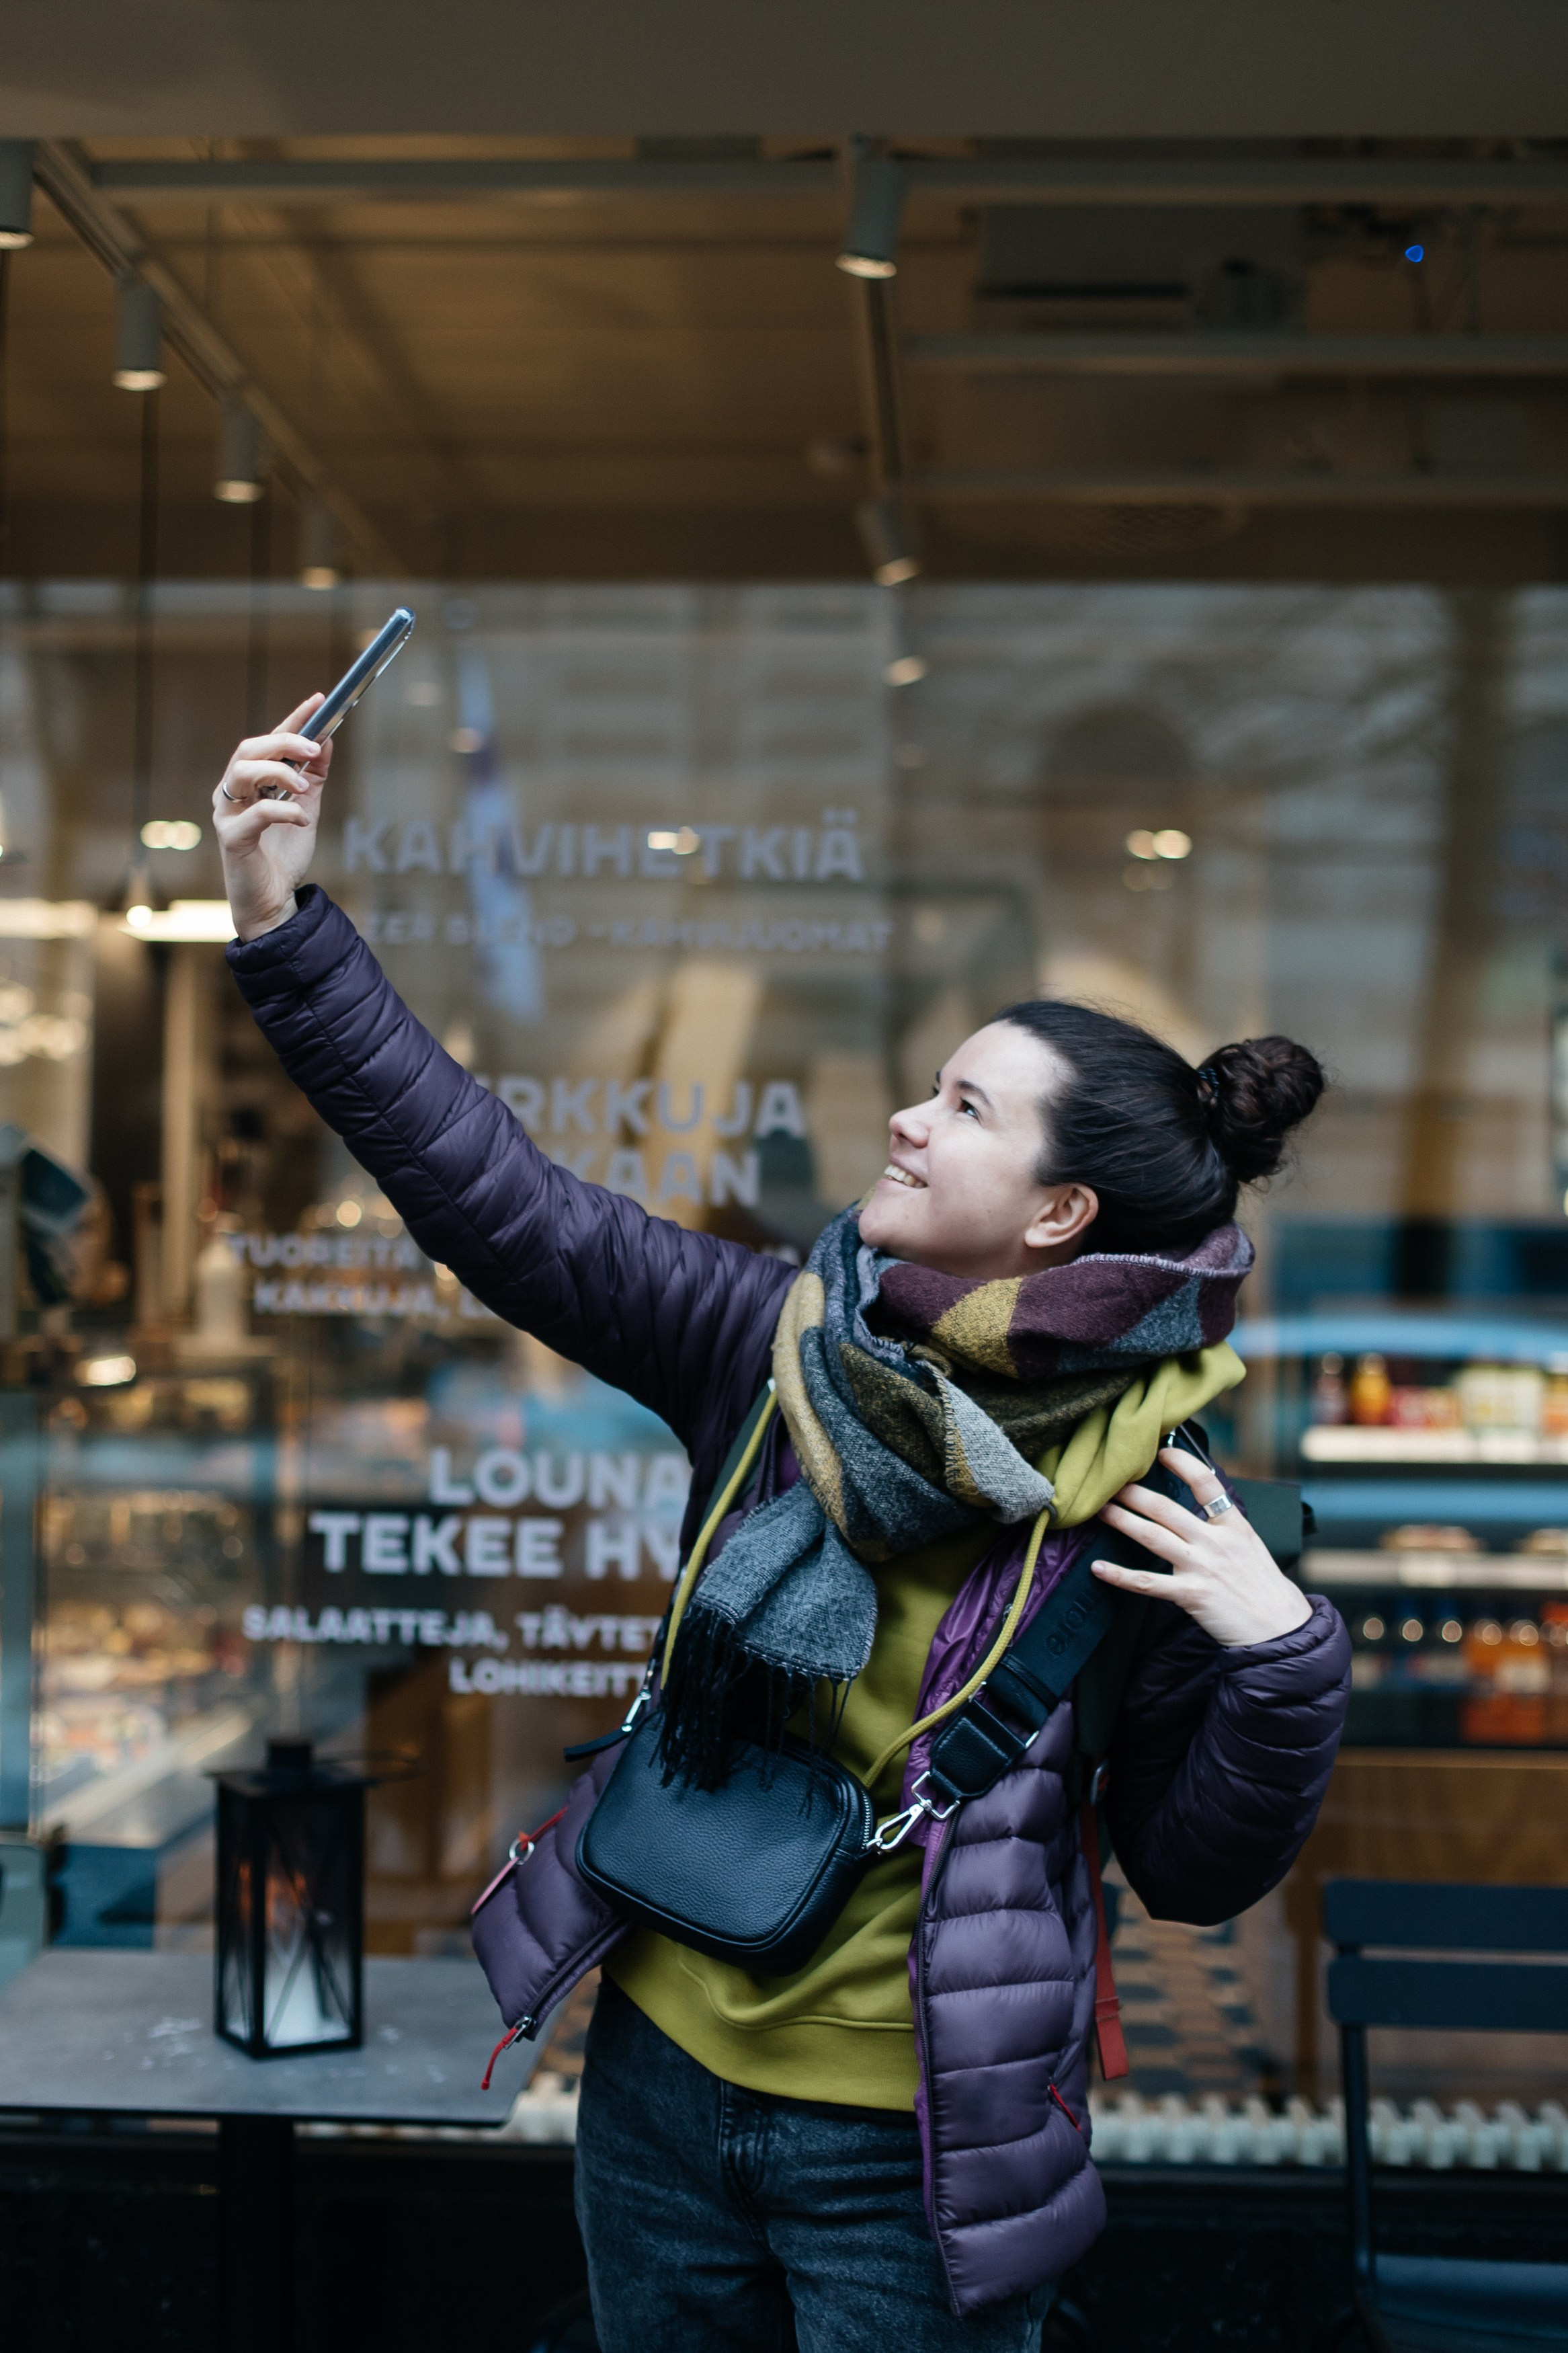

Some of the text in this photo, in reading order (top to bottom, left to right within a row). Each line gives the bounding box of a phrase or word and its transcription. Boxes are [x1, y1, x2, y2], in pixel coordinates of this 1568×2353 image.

[341, 808, 865, 881] KAHVIHETKIÄ
[475, 1075, 804, 1136] RKKUJA
[428, 1447, 691, 1509] LOUNA
[308, 1511, 681, 1581] TEKEE HY
[241, 1605, 509, 1652] SALAATTEJA,
[448, 1658, 651, 1699] LOHIKEITT
